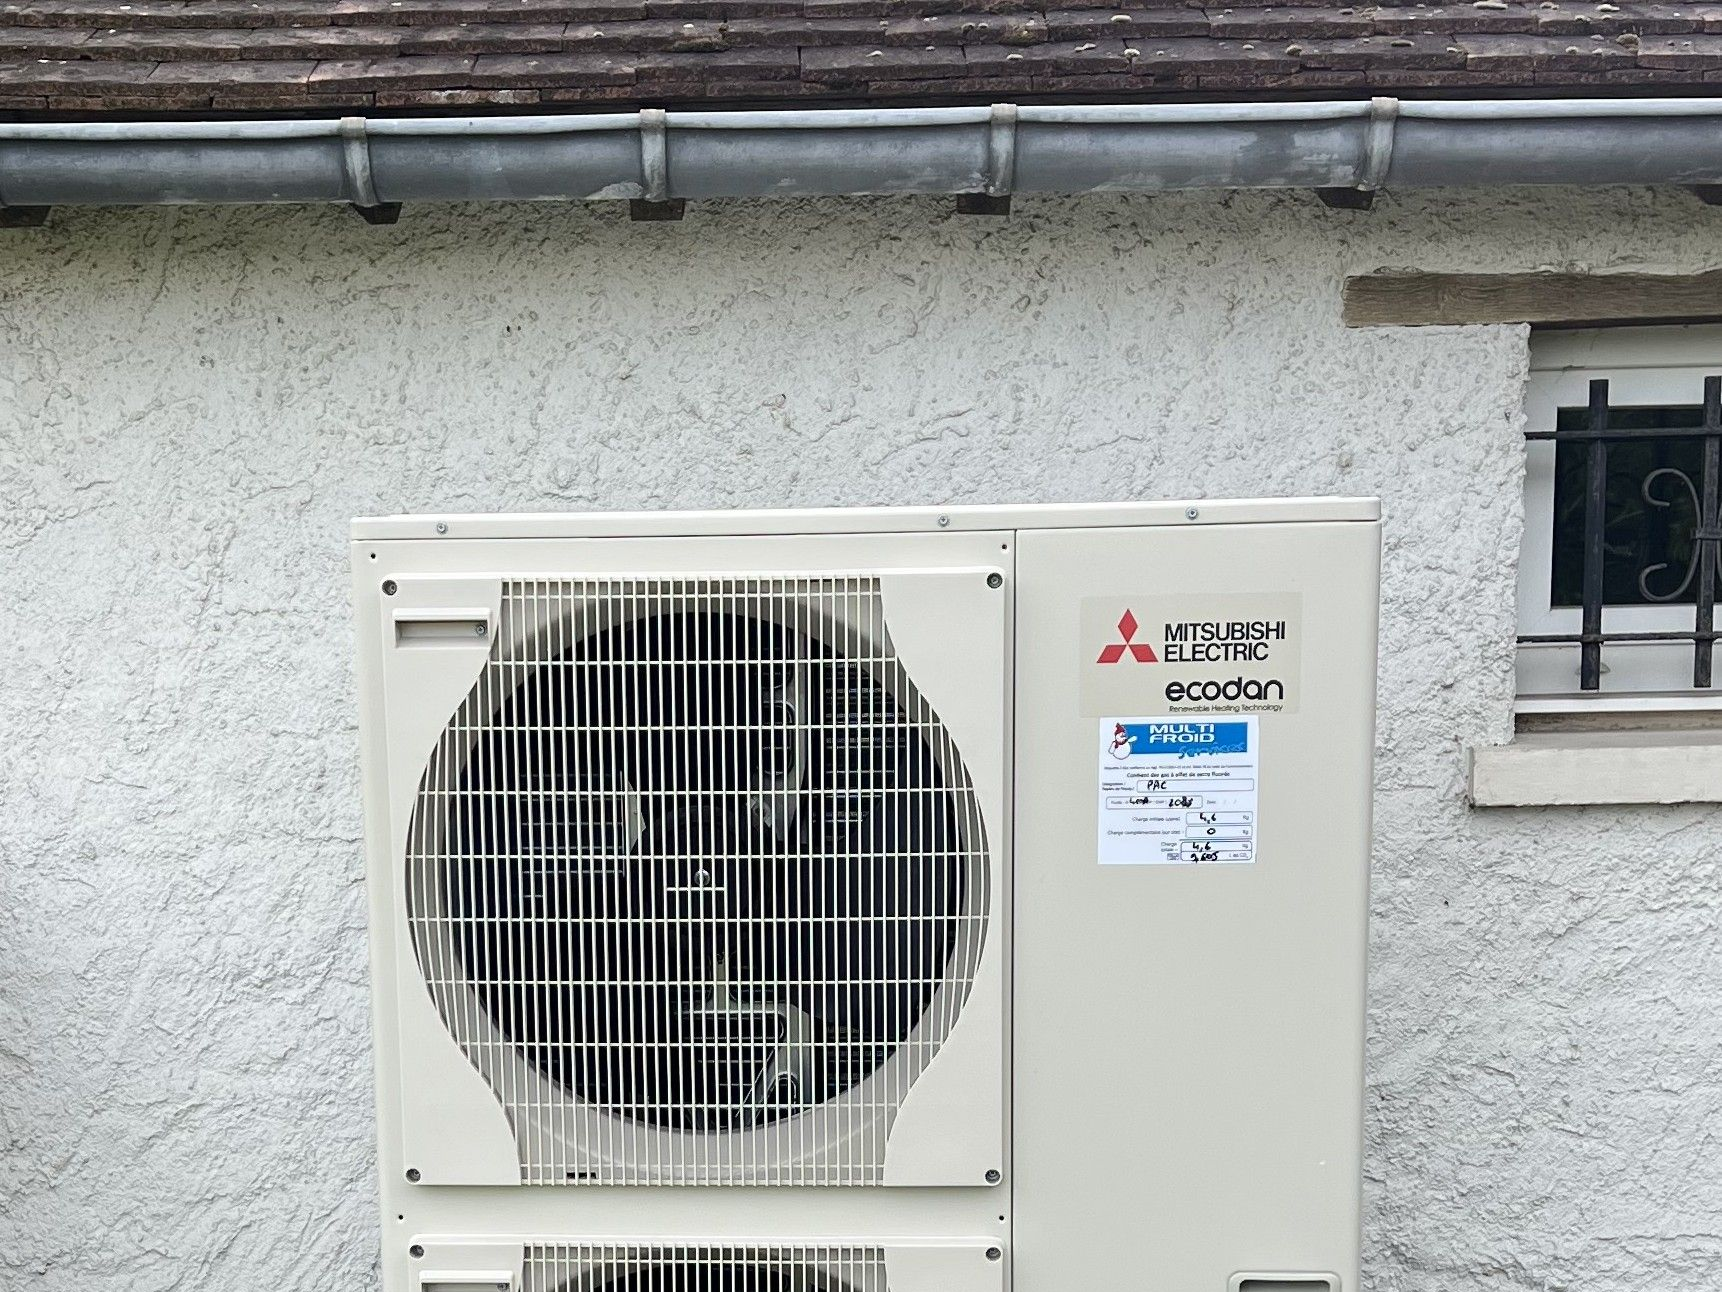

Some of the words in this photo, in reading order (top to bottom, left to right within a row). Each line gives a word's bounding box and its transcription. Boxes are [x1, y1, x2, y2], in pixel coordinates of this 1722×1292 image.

[1164, 621, 1286, 642] MITSUBISHI
[1164, 642, 1268, 662] ELECTRIC
[1165, 676, 1284, 701] ecodan
[1212, 704, 1240, 712] Heating
[1241, 704, 1284, 712] Technology
[1150, 724, 1214, 734] MULTI
[1150, 734, 1215, 744] FROID
[1147, 780, 1167, 791] PAC
